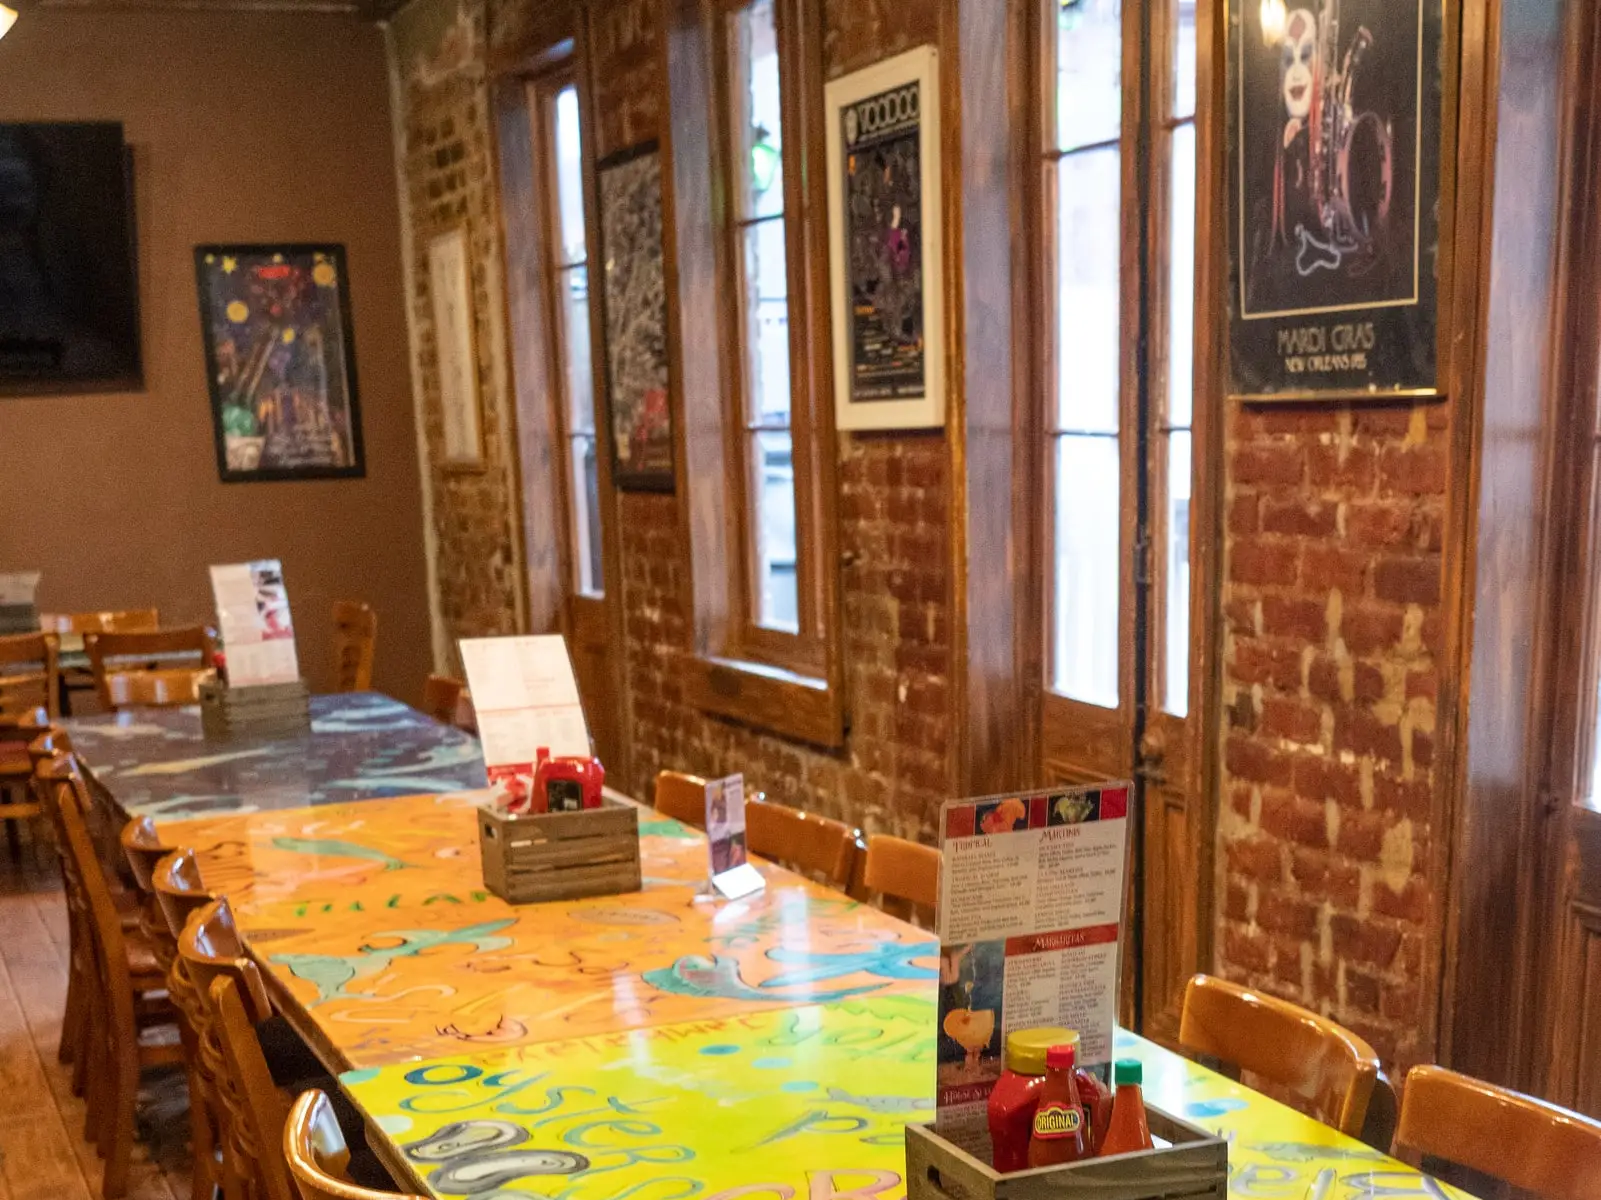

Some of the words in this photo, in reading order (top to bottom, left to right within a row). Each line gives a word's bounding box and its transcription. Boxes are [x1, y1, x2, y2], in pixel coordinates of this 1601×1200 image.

[858, 84, 919, 134] VOODOO
[1277, 326, 1326, 355] MARDI
[1330, 322, 1375, 351] GRAS
[1284, 355, 1305, 373] NEW
[1307, 354, 1350, 372] ORLEANS
[1037, 1114, 1078, 1131] ORIGINAL
